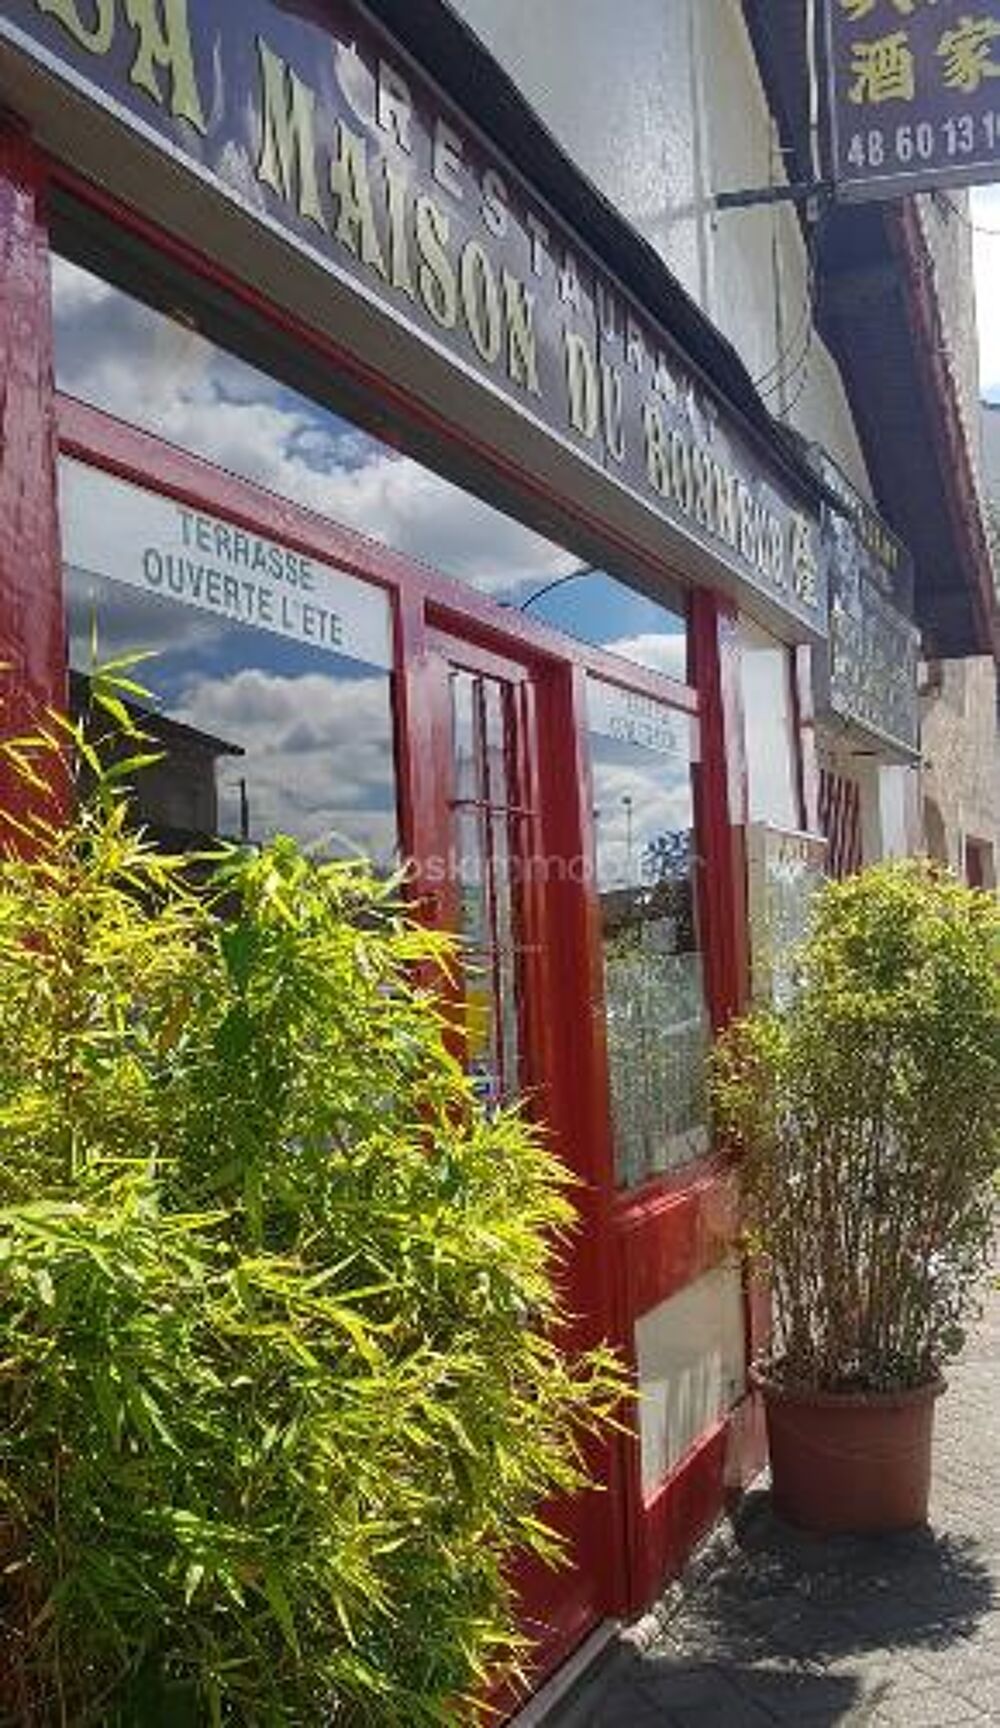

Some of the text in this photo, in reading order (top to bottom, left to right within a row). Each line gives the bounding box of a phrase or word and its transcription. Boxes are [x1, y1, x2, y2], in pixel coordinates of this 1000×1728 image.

[847, 130, 884, 167] 48
[896, 122, 934, 162] 60
[942, 114, 973, 156] 13
[257, 34, 541, 398] MAISON
[565, 329, 625, 463] DU
[374, 57, 719, 444] RESTAURANT
[142, 547, 273, 624] OUVERTE
[177, 507, 318, 592] TERRASSE
